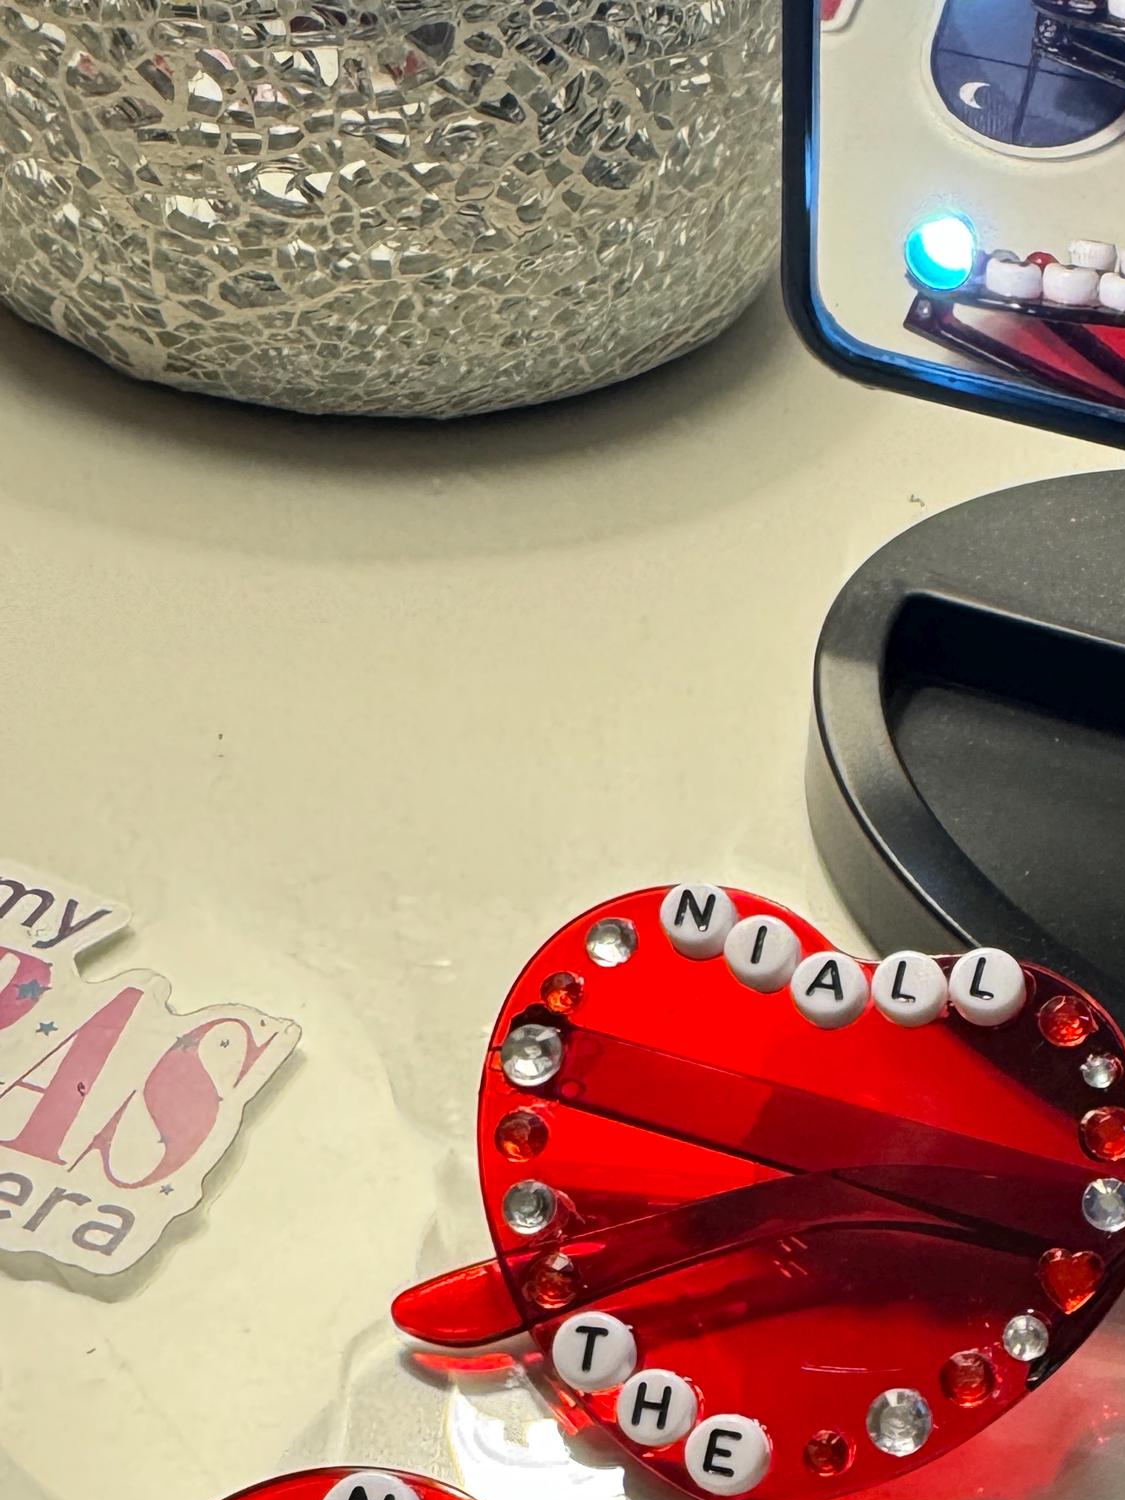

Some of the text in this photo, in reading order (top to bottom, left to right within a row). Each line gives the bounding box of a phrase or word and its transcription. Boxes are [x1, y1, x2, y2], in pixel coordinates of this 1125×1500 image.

[673, 888, 995, 1003] NIALL
[0, 1171, 136, 1257] era
[574, 1325, 743, 1479] THE
